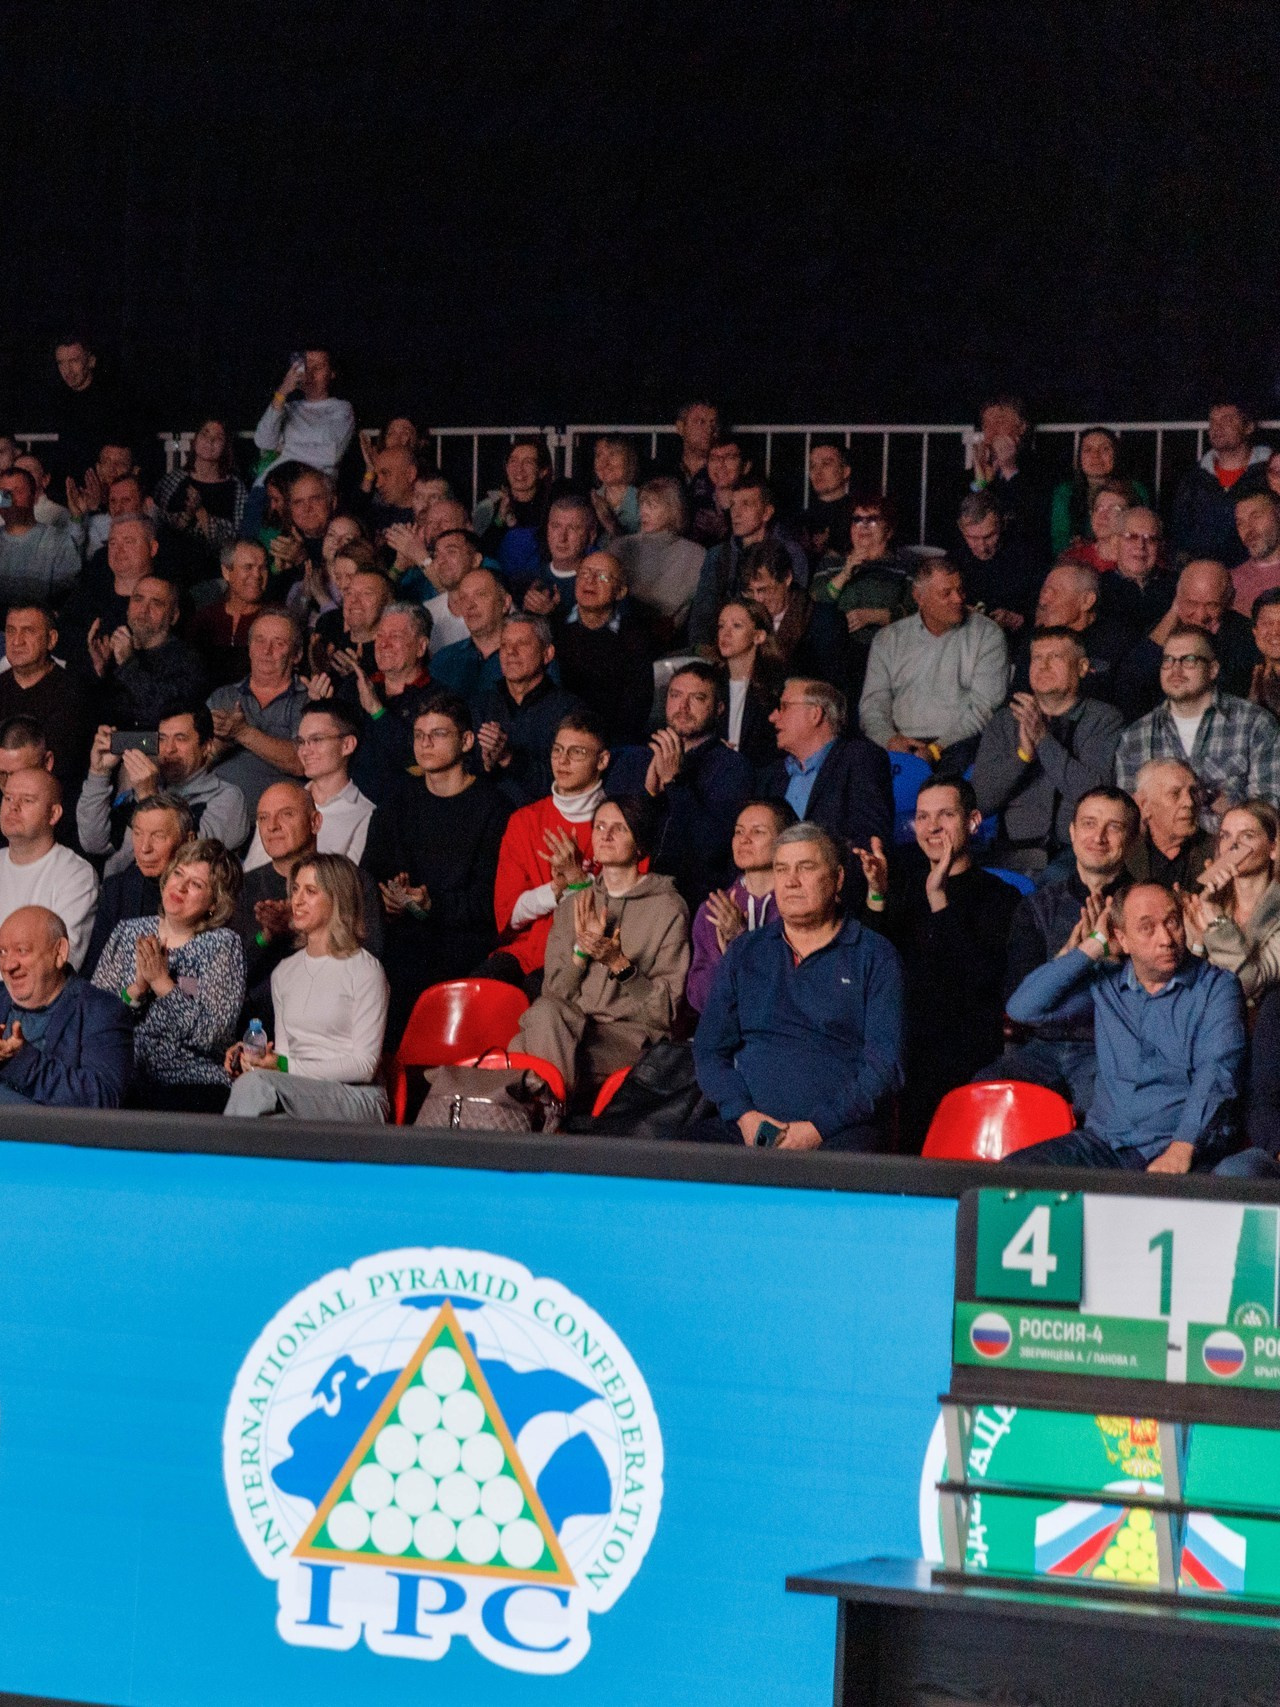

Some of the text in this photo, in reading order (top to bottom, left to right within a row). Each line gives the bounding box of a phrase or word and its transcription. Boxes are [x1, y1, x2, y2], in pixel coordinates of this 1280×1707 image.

[1001, 1205, 1058, 1287] 4
[1148, 1229, 1174, 1316] 1
[1020, 1318, 1103, 1344] РОССИЯ-4
[240, 1289, 356, 1559] INTERNATIONAL
[366, 1267, 520, 1303] PYRAMID
[533, 1298, 647, 1593] CONFEDERATION
[295, 1561, 572, 1654] IPC
